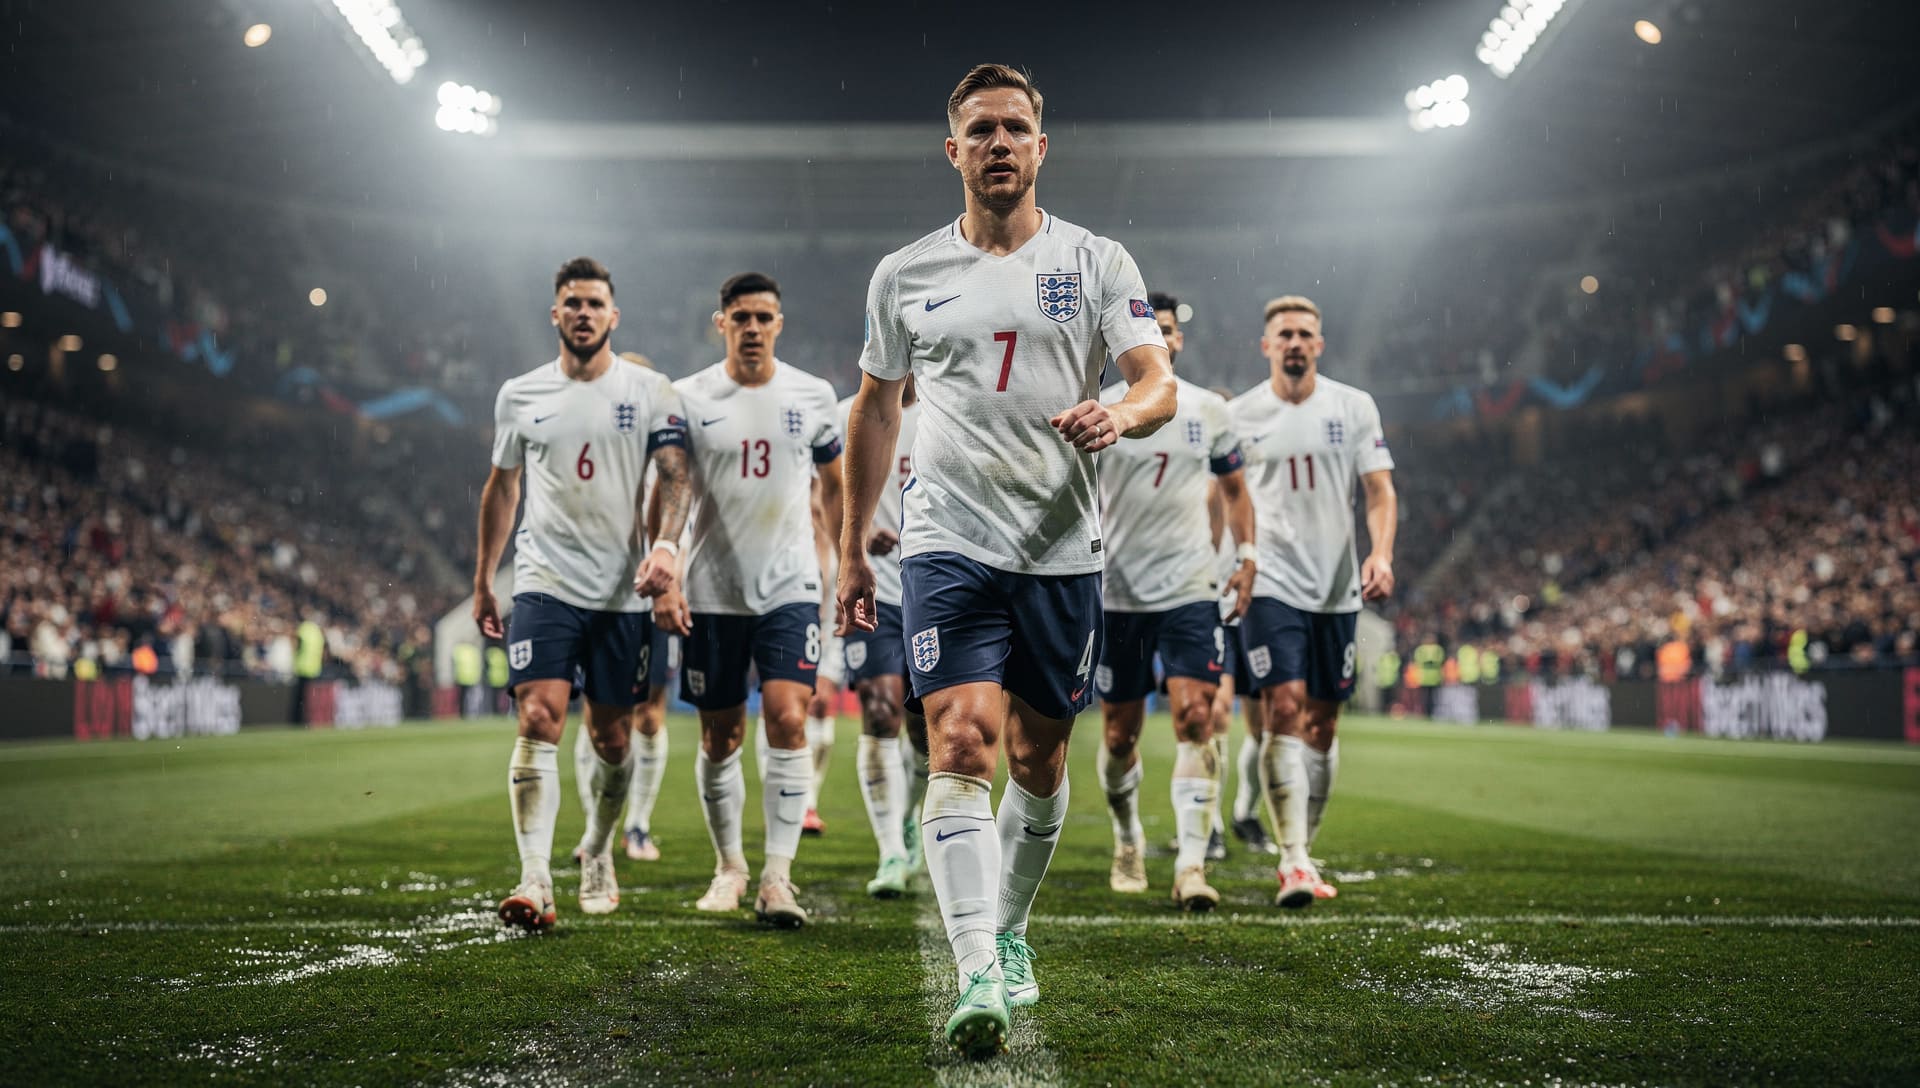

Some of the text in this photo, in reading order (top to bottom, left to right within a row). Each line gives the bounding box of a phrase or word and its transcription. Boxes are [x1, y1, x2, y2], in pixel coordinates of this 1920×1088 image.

[993, 331, 1017, 392] 7
[577, 442, 594, 480] 6
[741, 439, 770, 479] 13
[1154, 452, 1168, 488] 7
[1288, 455, 1315, 490] 11
[804, 622, 821, 663] 8
[1076, 629, 1095, 682] 4
[1342, 641, 1356, 679] 8
